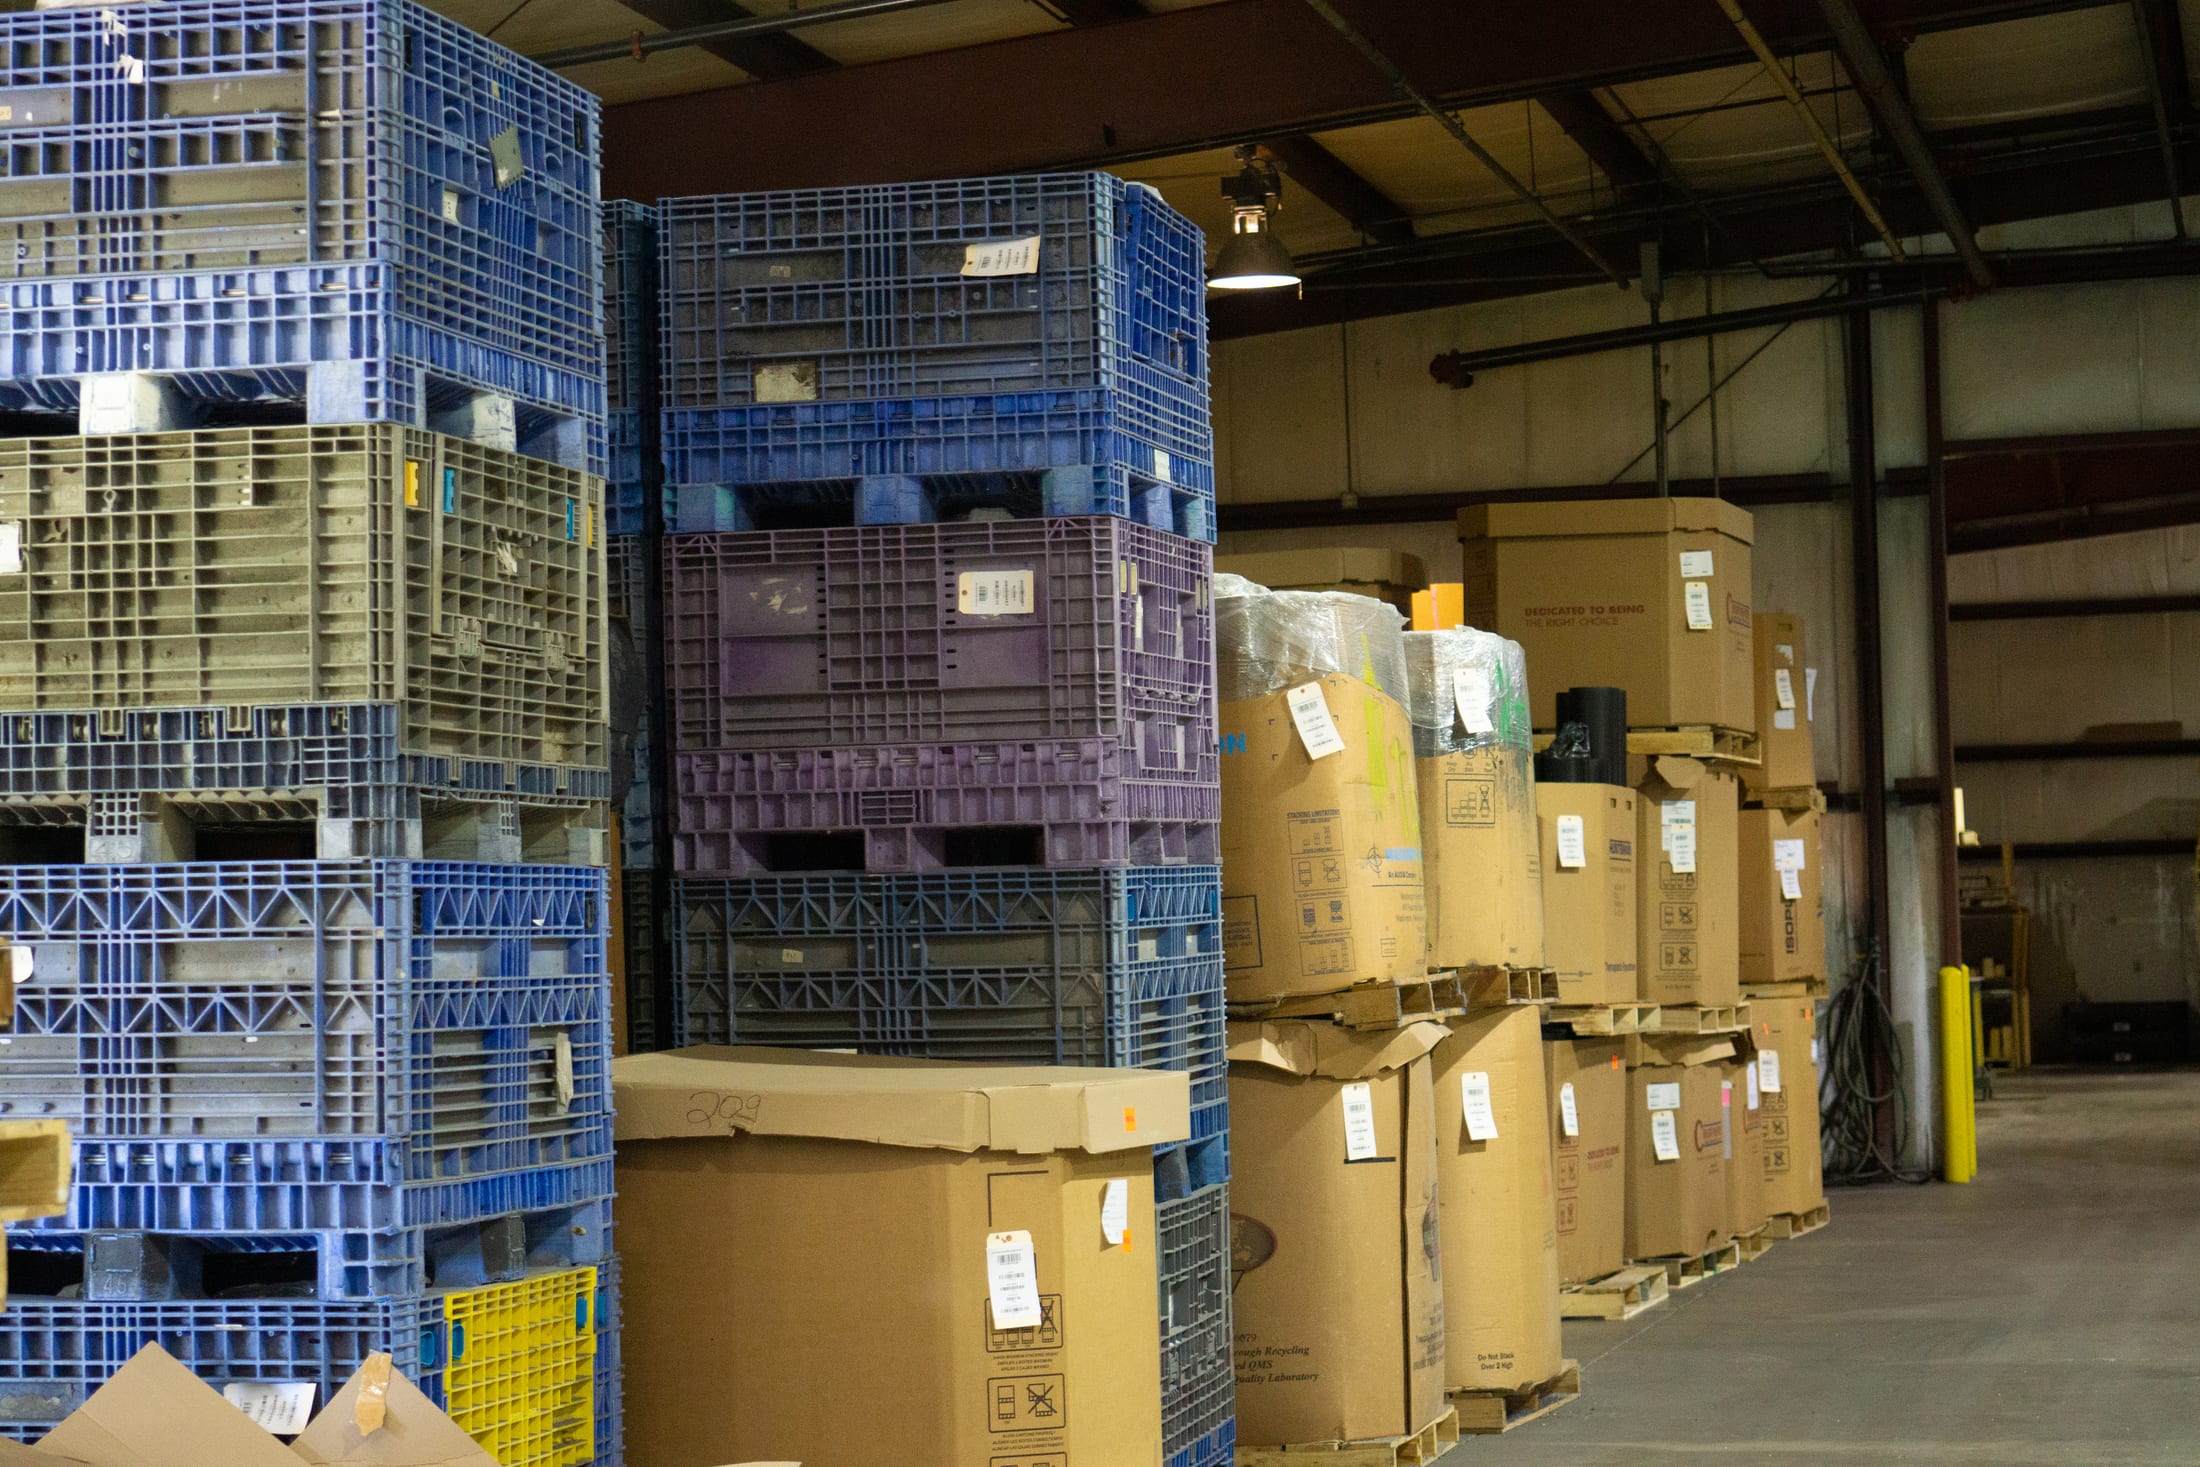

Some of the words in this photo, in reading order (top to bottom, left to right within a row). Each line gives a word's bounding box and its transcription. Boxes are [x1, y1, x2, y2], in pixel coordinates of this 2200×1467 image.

[1524, 606, 1585, 616] DEDICATED
[1589, 606, 1605, 615] TO
[1609, 604, 1645, 614] BEING
[1525, 618, 1543, 627] THE
[1545, 617, 1577, 627] RIGHT
[1578, 616, 1619, 626] CHOICE
[1265, 1346, 1309, 1357] Recycling
[1248, 1360, 1273, 1372] QMS
[1267, 1373, 1319, 1383] Laboratory
